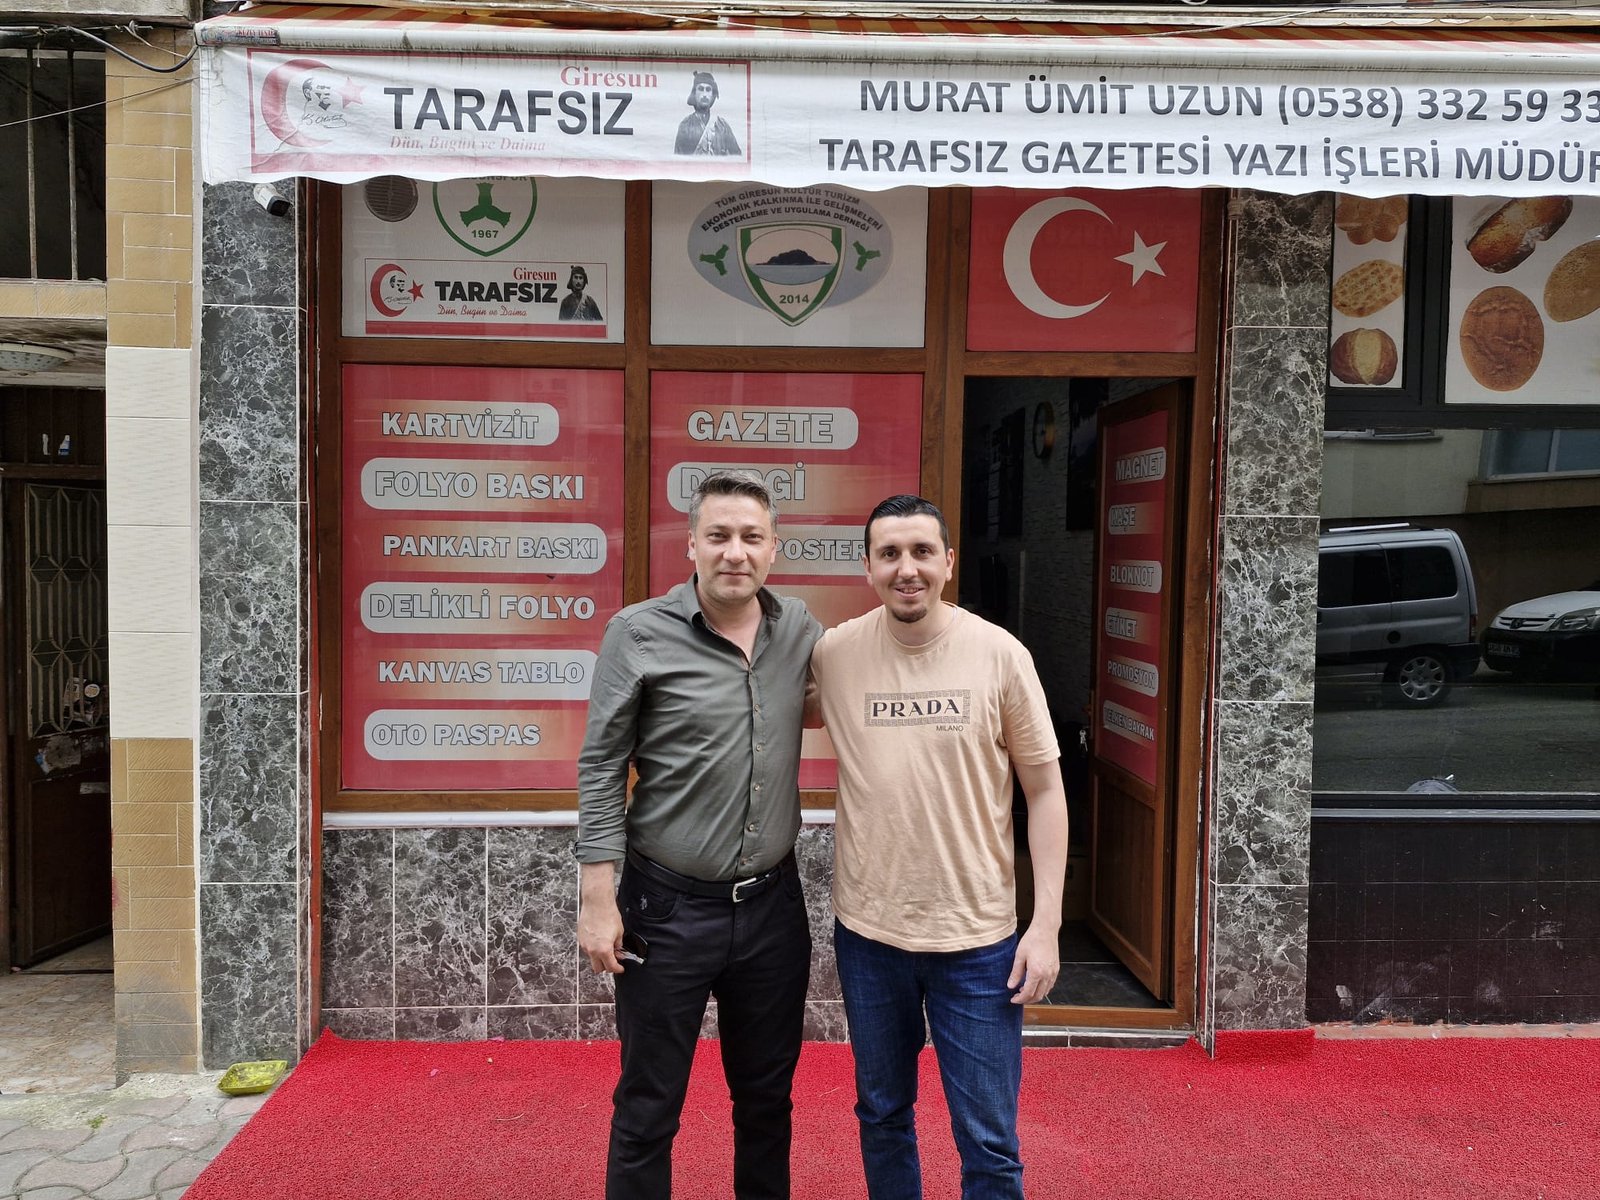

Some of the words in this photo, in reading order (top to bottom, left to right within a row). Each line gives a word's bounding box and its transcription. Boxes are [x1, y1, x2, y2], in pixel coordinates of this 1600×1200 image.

[561, 65, 658, 88] Giresun
[384, 87, 634, 135] TARAFSIZ
[860, 80, 1011, 112] MURAT
[1025, 74, 1134, 114] ÜMİT
[1148, 84, 1263, 117] UZUN
[1278, 85, 1403, 127] (0538)
[1417, 88, 1488, 121] 332
[1501, 89, 1548, 122] 59
[1560, 89, 1600, 123] 33
[390, 135, 424, 150] Dün,
[429, 136, 475, 152] Bugün
[480, 140, 496, 150] ve
[500, 137, 546, 151] Daima
[819, 138, 1008, 173] TARAFSIZ
[1021, 135, 1210, 175] GAZETESİ
[1224, 143, 1307, 176] YAZI
[1323, 137, 1440, 185] İŞLERİ
[714, 195, 737, 208] TÜM
[738, 188, 781, 201] GİRESUN
[824, 190, 861, 205] TURİZM
[701, 202, 751, 232] EKONOMİK
[753, 196, 804, 208] KALKINMA
[806, 196, 821, 205] İLE
[823, 199, 883, 231] GELİŞMELERİ
[712, 208, 769, 233] DESTEKLEME
[770, 207, 783, 215] VE
[784, 207, 831, 217] UYGULAMA
[833, 212, 870, 232] DERNEĞİ
[471, 229, 499, 239] 1967
[513, 267, 558, 282] Giresun
[434, 281, 558, 304] TARAFSIZ
[779, 294, 810, 304] 2014
[500, 305, 528, 317] Daima
[382, 408, 539, 439] KARTVİZİT
[687, 410, 834, 444] GAZETE
[1115, 450, 1164, 481] MAGNET
[375, 471, 478, 498] FOLYO
[487, 473, 584, 500] BASKI
[680, 461, 806, 500] DGİ
[383, 535, 511, 558] PANKART
[517, 537, 599, 560] BASKI
[1110, 565, 1155, 588] BLOKNOT
[370, 588, 490, 619] DELİKLİ
[500, 595, 596, 620] FOLYO
[1106, 611, 1137, 639] ETİKET
[378, 661, 492, 684] KANVAS
[498, 661, 585, 684] TABLO
[1107, 660, 1156, 690] PROMOSYON
[872, 699, 961, 718] PRADA
[371, 724, 427, 746] OTO
[433, 724, 541, 746] PASPAS
[1127, 717, 1155, 741] BAYRAK
